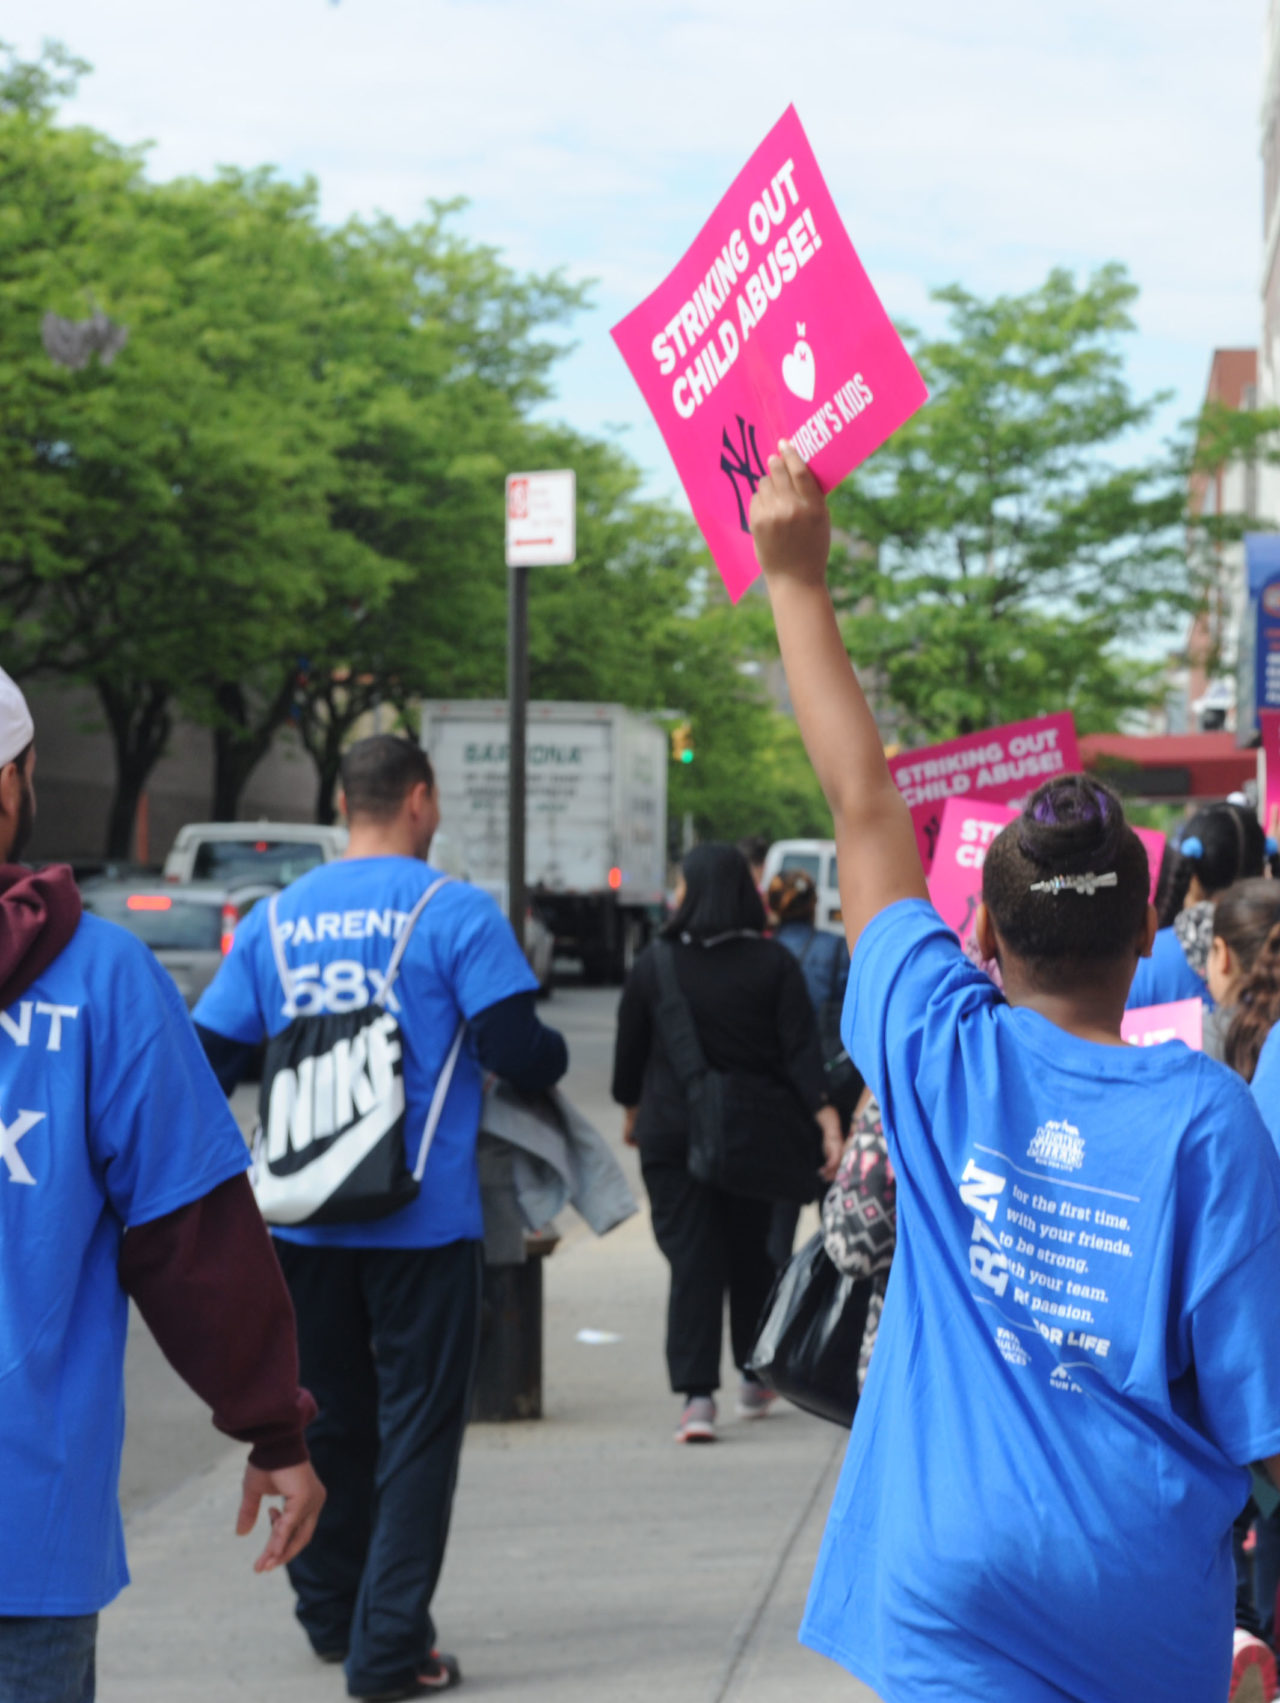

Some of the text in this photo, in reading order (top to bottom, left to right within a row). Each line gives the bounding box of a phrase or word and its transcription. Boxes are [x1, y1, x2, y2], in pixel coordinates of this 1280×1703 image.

[651, 158, 802, 376] STRIKING OUT
[671, 207, 823, 419] CHILD ABUSE!
[788, 372, 875, 464] UREN'S KIDS
[895, 728, 1059, 788] STRIKING OUT
[901, 750, 1064, 809] CHILD ABUSE!
[278, 908, 412, 946] PARENT
[268, 1012, 402, 1164] NIKE
[1007, 1208, 1132, 1257] with your friends.
[1032, 1195, 1057, 1214] the
[1059, 1201, 1091, 1221] first
[1094, 1209, 1130, 1231] time.
[999, 1230, 1088, 1274] to be strong.
[1007, 1259, 1109, 1303] th your team.
[1031, 1297, 1095, 1324] passion.
[1067, 1330, 1111, 1358] LIFE
